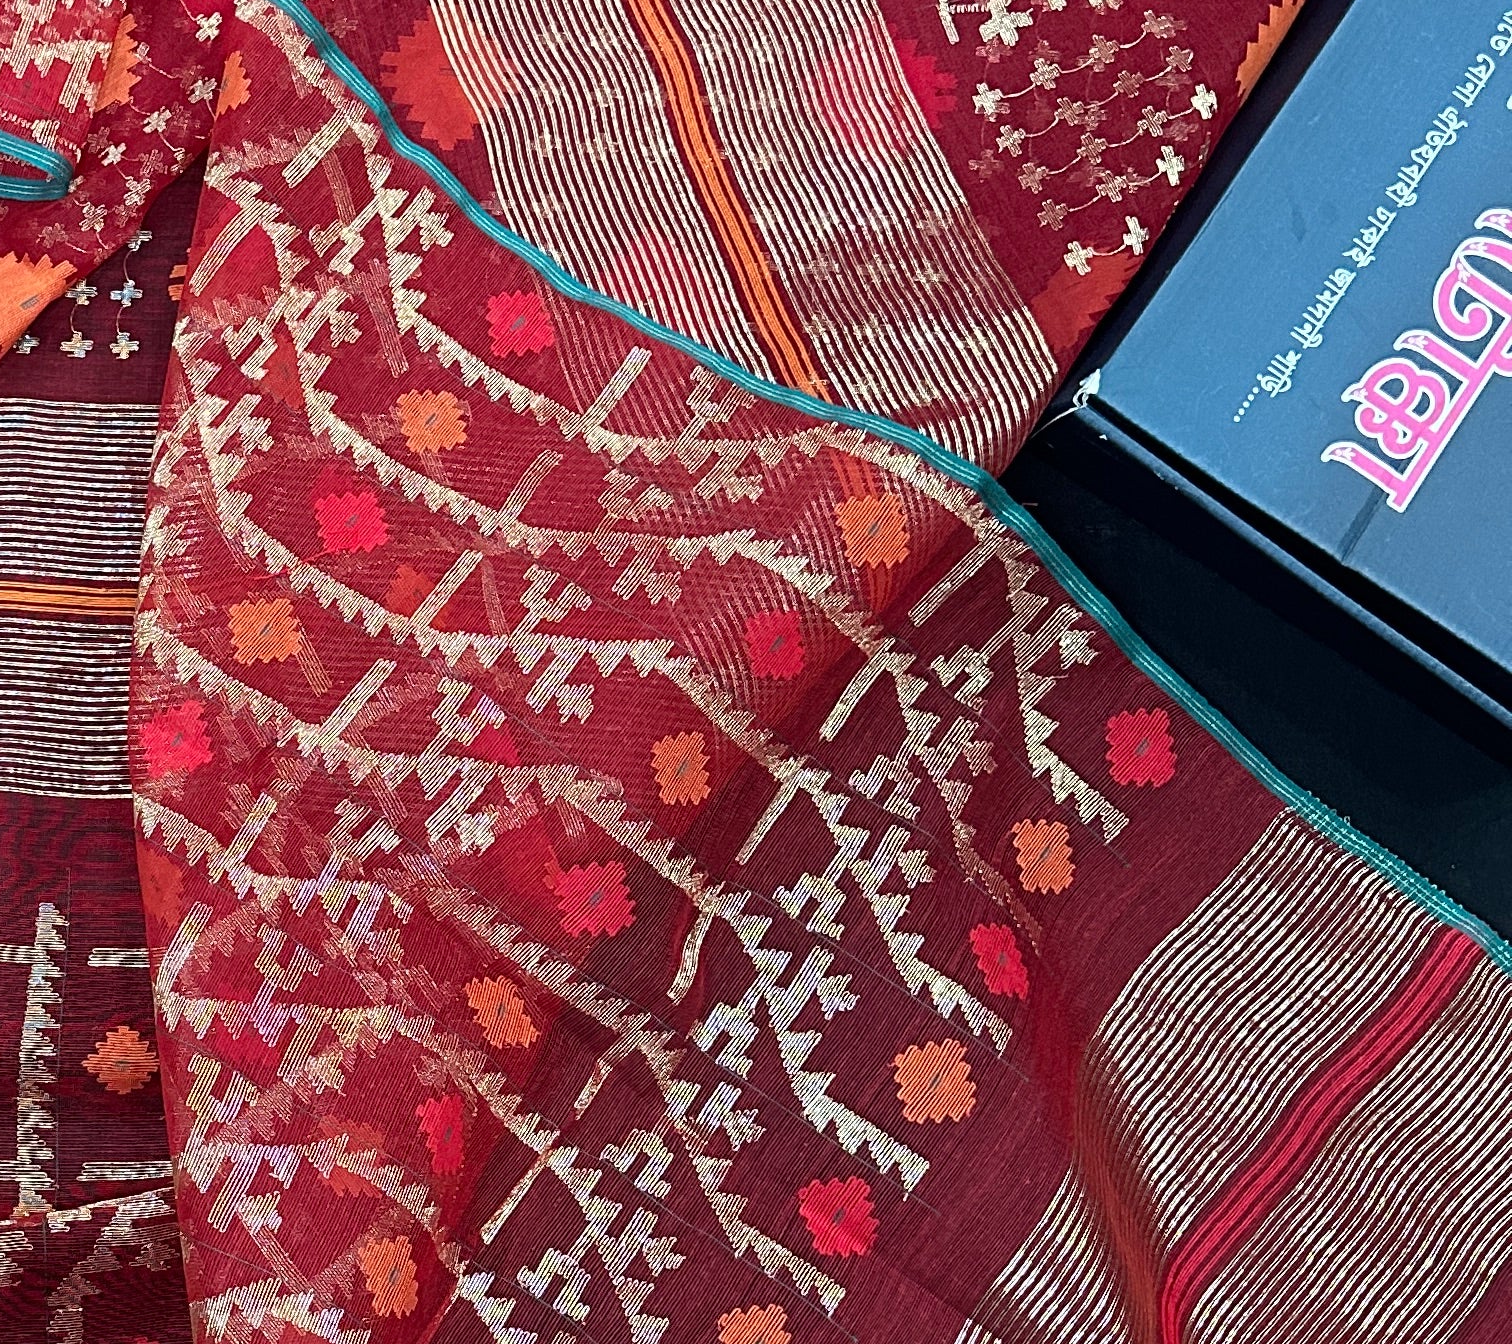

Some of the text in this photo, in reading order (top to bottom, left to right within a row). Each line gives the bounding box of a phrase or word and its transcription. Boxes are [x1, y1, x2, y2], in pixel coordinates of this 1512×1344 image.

[1452, 54, 1495, 107] বোনা
[1386, 107, 1468, 207] ঐতিহ্যবাহী
[1343, 207, 1396, 267] ঢাকাই
[1291, 269, 1356, 349] জামদানী
